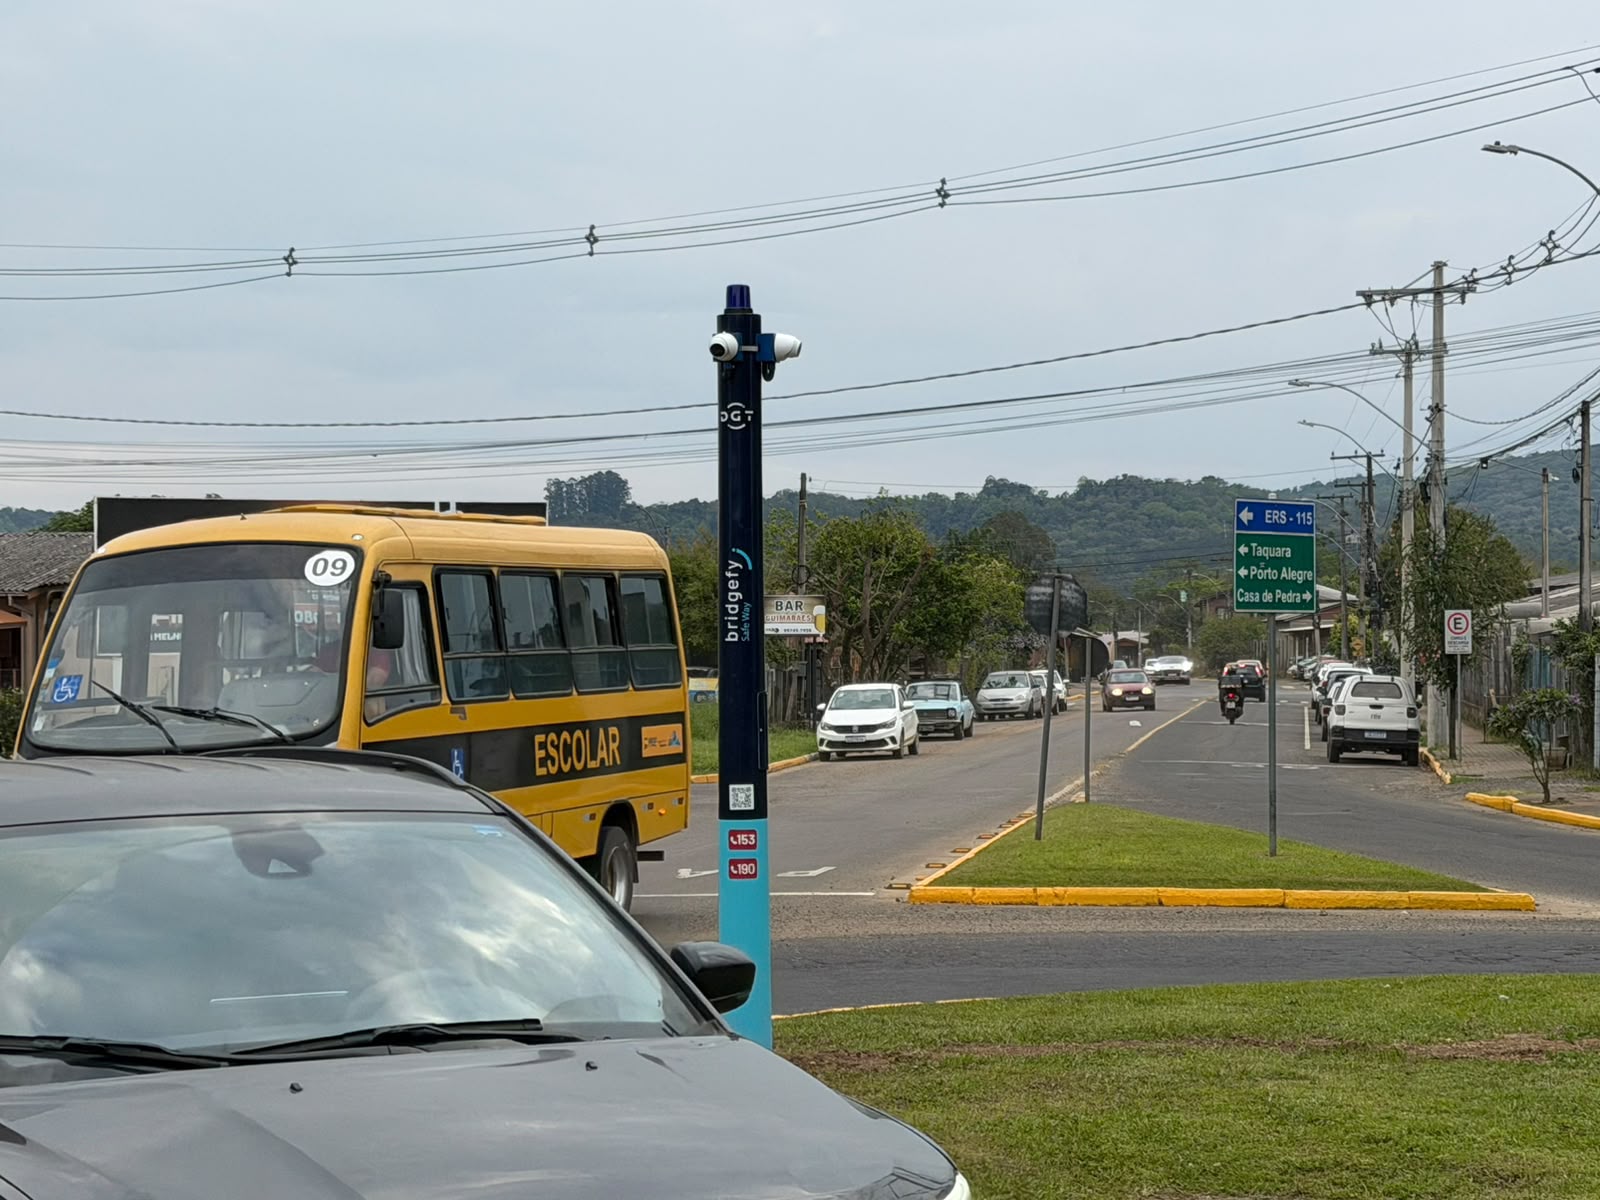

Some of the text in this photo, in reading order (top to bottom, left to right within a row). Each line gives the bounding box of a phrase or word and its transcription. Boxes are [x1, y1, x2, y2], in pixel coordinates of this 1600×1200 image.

[1265, 510, 1287, 524] ERS
[1296, 512, 1313, 525] 115
[1250, 542, 1292, 560] Taquara
[312, 557, 347, 577] 09
[1250, 566, 1313, 584] Porto Alegre
[724, 560, 743, 642] bridgefy
[1237, 588, 1301, 603] Casa de Pedra
[775, 600, 804, 611] BAR
[741, 601, 752, 642] Safe Way
[1454, 618, 1463, 630] E
[534, 726, 621, 776] ESCOLAR
[737, 834, 756, 845] 153
[738, 863, 756, 875] 190
